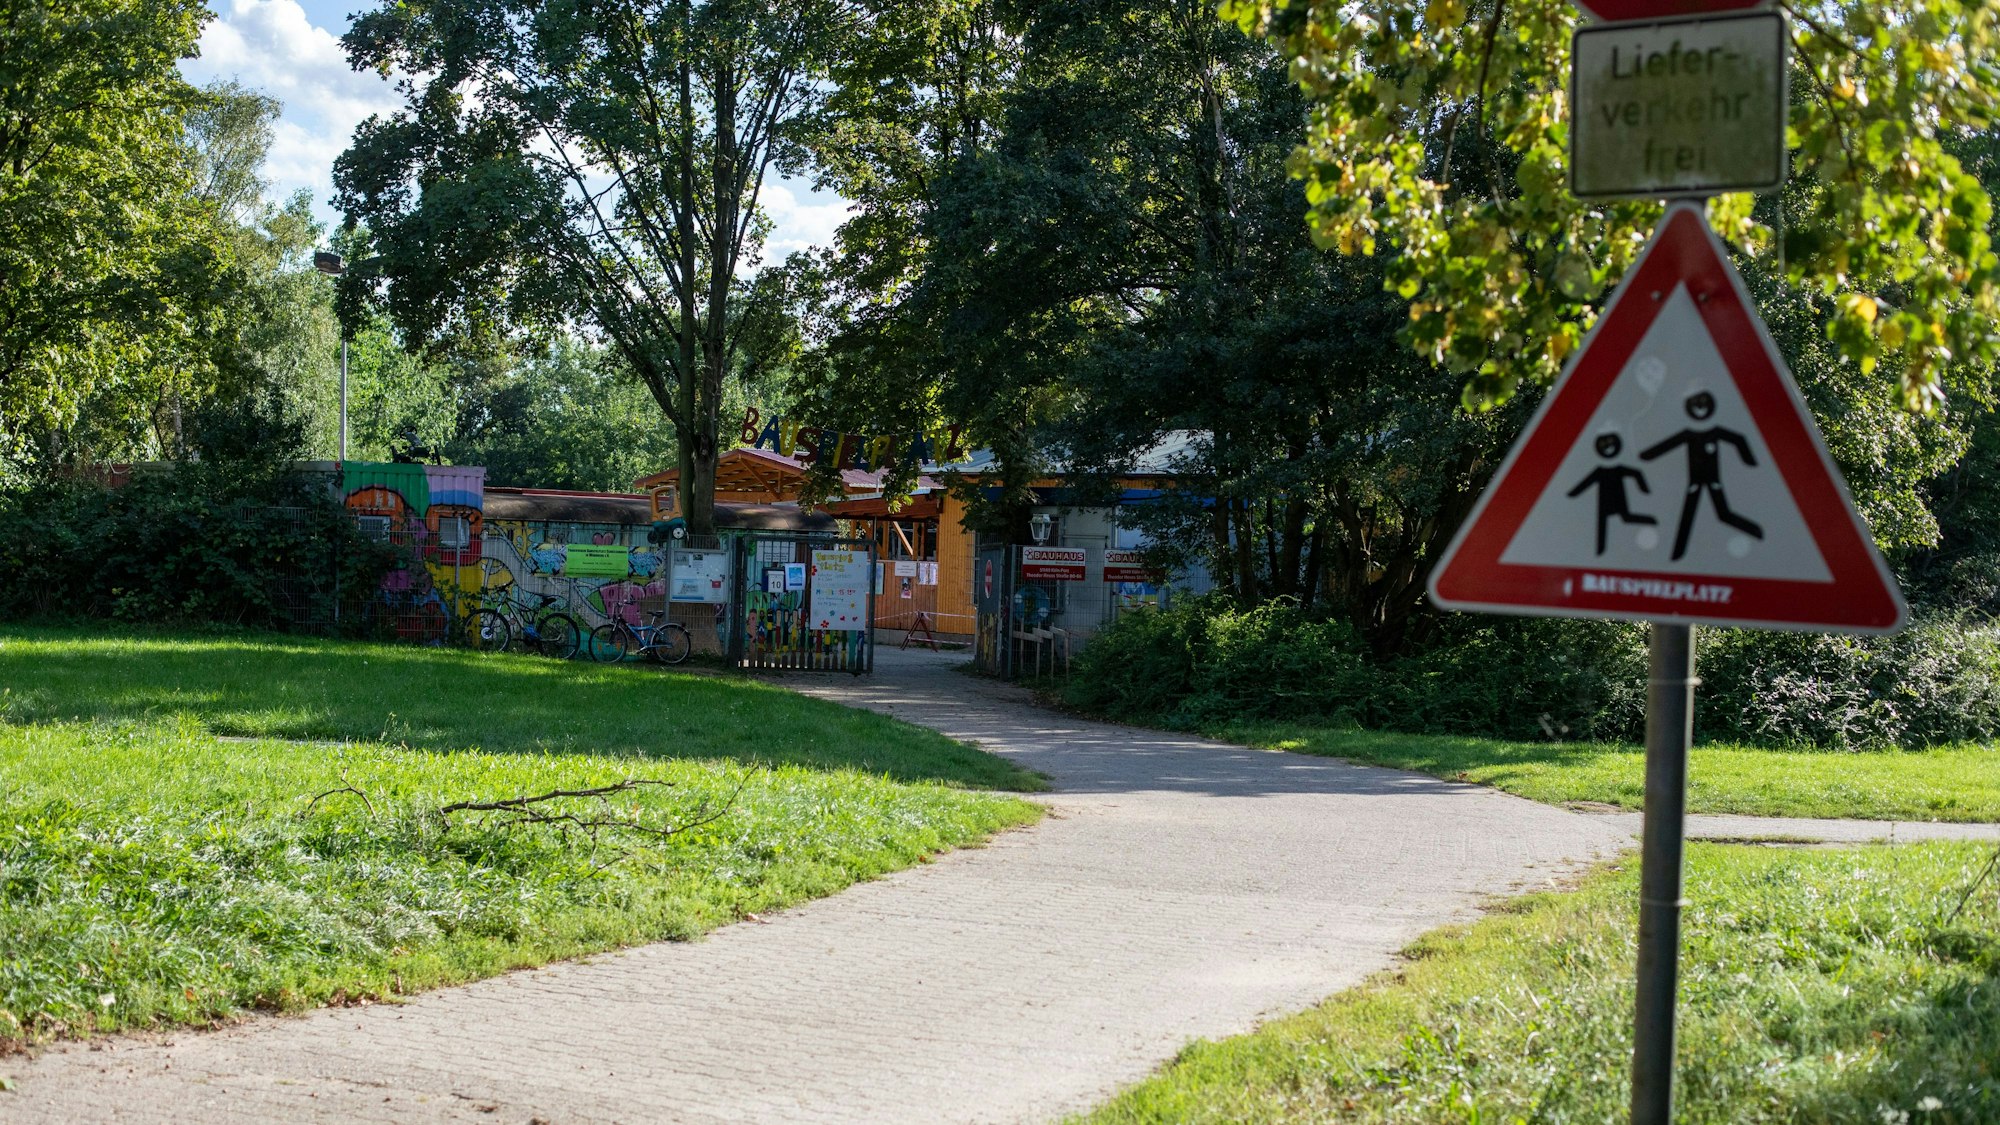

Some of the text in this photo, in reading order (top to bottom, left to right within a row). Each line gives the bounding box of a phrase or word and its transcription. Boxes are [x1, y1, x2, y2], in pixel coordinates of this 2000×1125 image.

[1611, 40, 1742, 80] Liefer-
[1601, 86, 1751, 128] verkehr
[1643, 138, 1707, 174] frei
[1034, 551, 1084, 561] BAUHAUS
[771, 581, 781, 589] 10
[1582, 573, 1734, 604] BAUSPIELPLATZ
